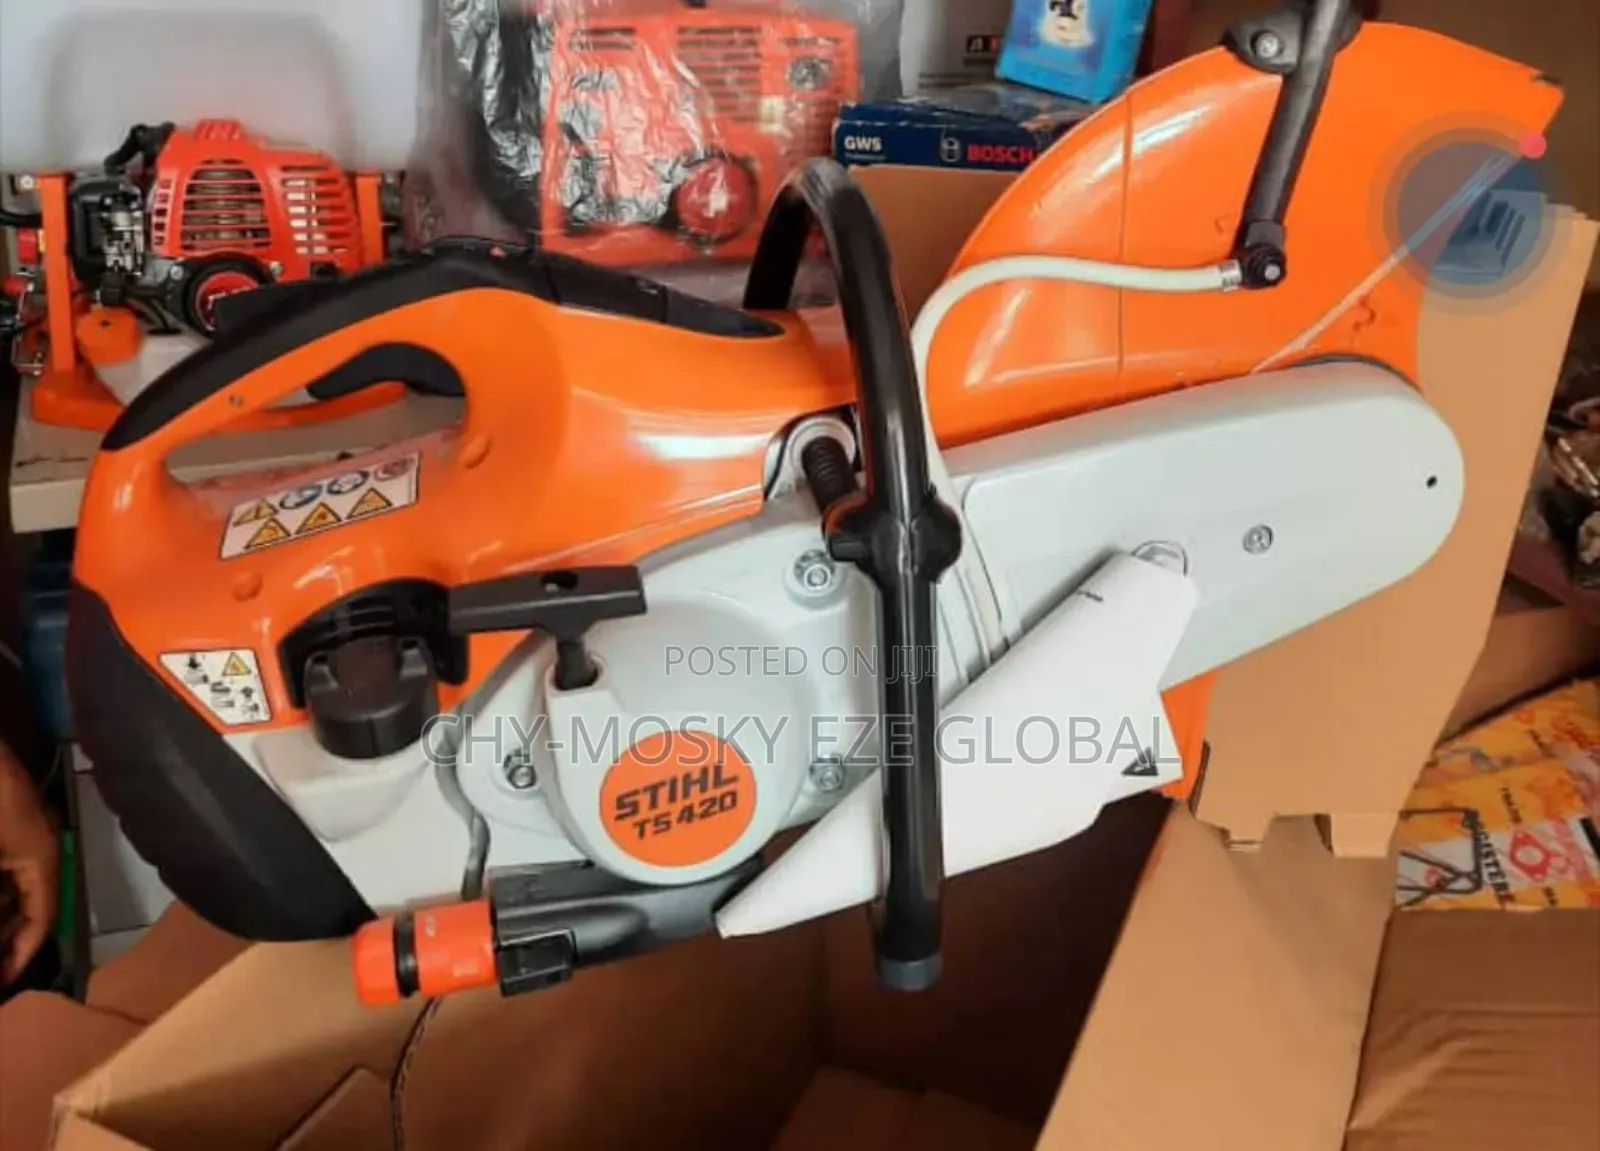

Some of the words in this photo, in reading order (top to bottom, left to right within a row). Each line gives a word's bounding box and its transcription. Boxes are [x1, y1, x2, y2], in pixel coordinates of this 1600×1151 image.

[843, 136, 883, 151] GWS
[967, 144, 1034, 163] BOSCH
[614, 764, 739, 822] STIHL
[632, 811, 672, 840] TS
[676, 790, 738, 824] 420
